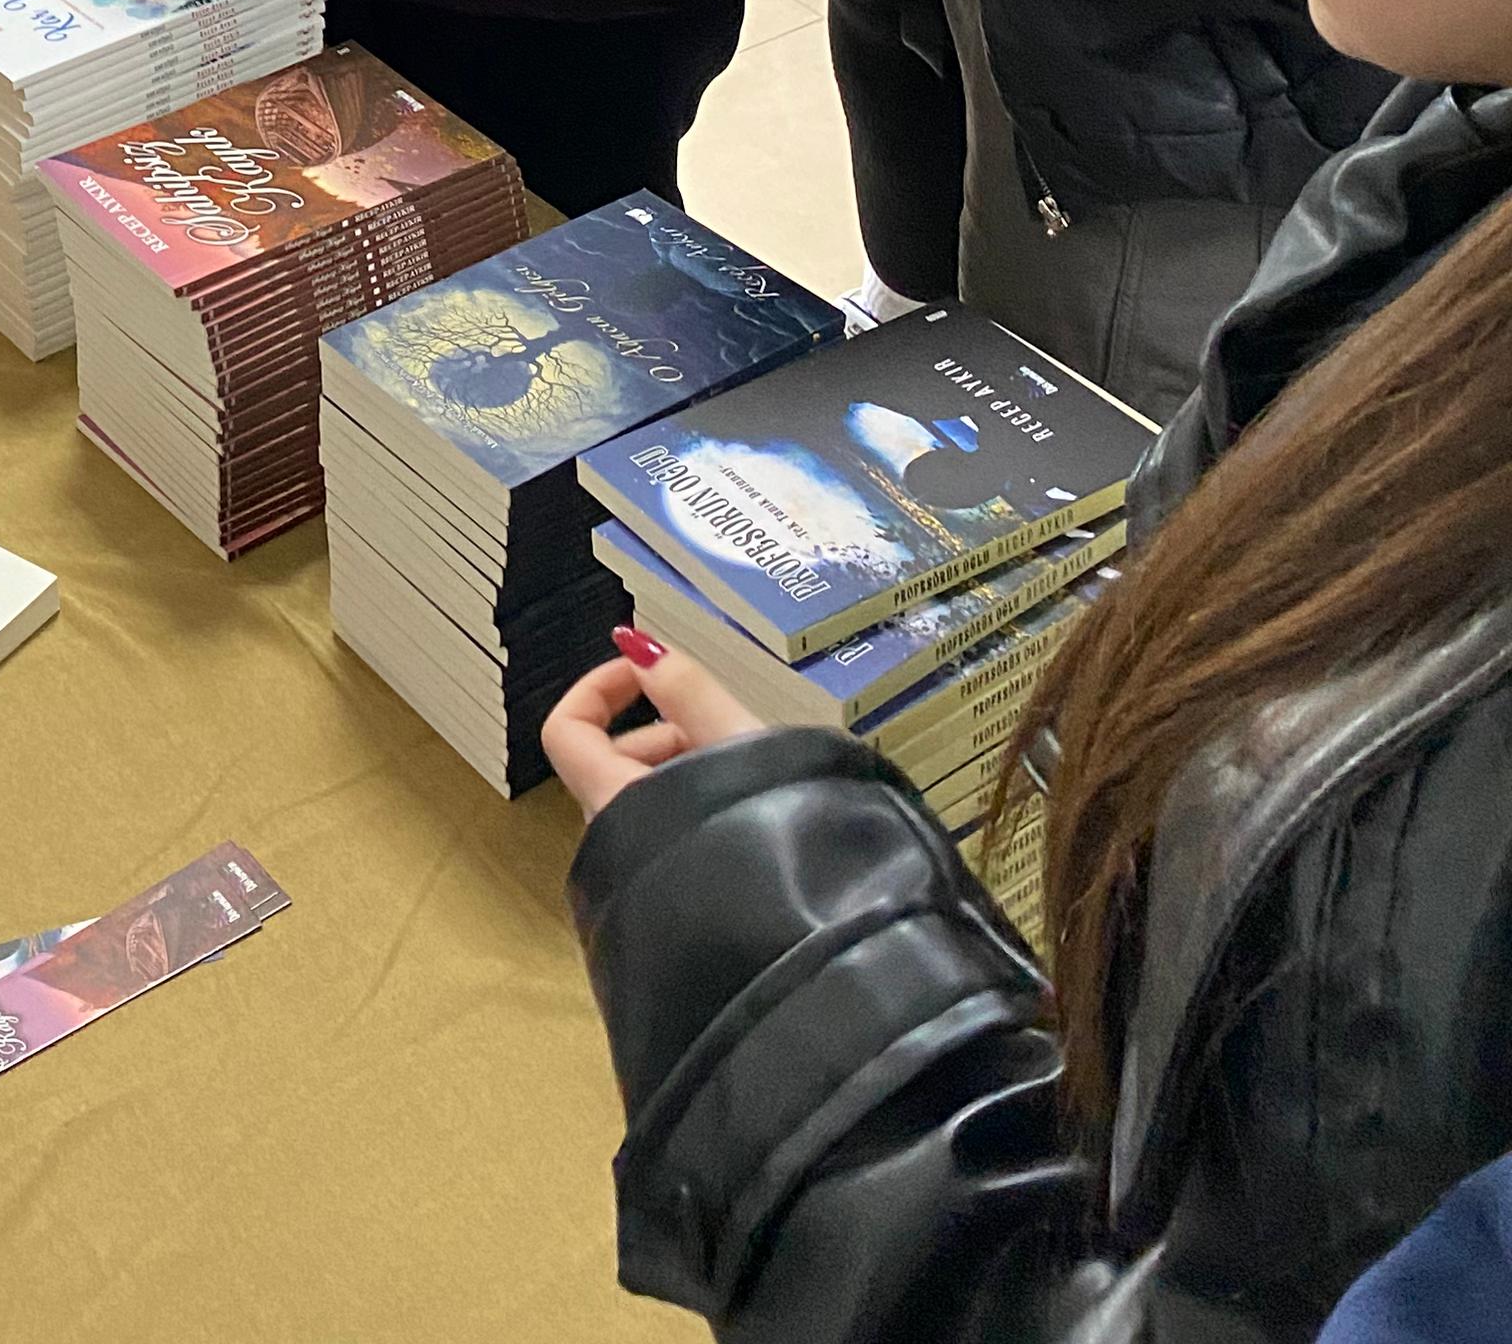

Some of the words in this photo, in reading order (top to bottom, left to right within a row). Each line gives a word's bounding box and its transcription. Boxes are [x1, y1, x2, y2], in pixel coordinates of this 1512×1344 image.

[31, 7, 83, 43] Kar
[118, 141, 260, 245] Sahipsiz
[174, 127, 304, 215] Kayık
[79, 176, 128, 213] AYKIR
[117, 214, 169, 253] RECEP
[649, 365, 684, 383] O
[930, 356, 996, 400] AYKIR
[986, 396, 1055, 443] RECEP
[679, 487, 831, 603] PROFESÖRÜN
